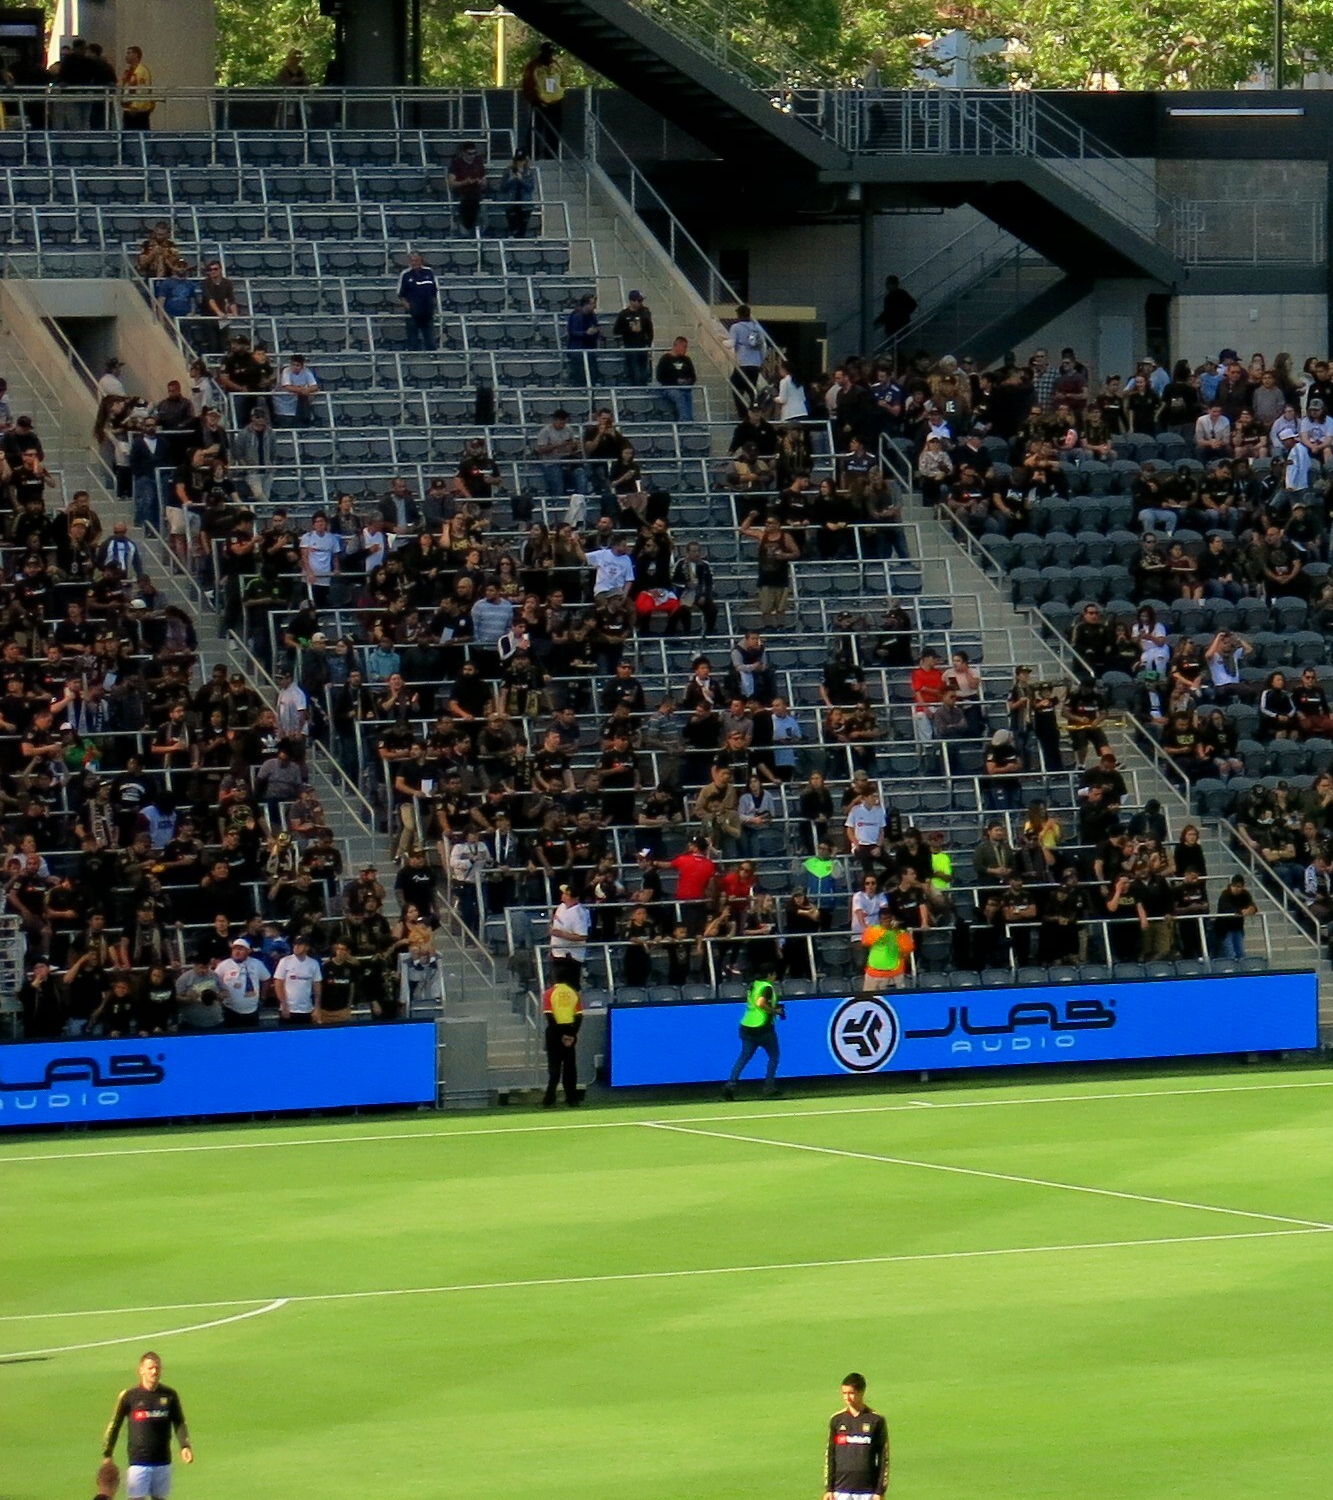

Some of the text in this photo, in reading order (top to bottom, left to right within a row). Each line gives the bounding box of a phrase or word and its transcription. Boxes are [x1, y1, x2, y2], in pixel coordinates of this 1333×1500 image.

[905, 1000, 1116, 1039] JLAB
[951, 1035, 1075, 1053] AUDIO
[0, 1091, 120, 1110] UDIO
